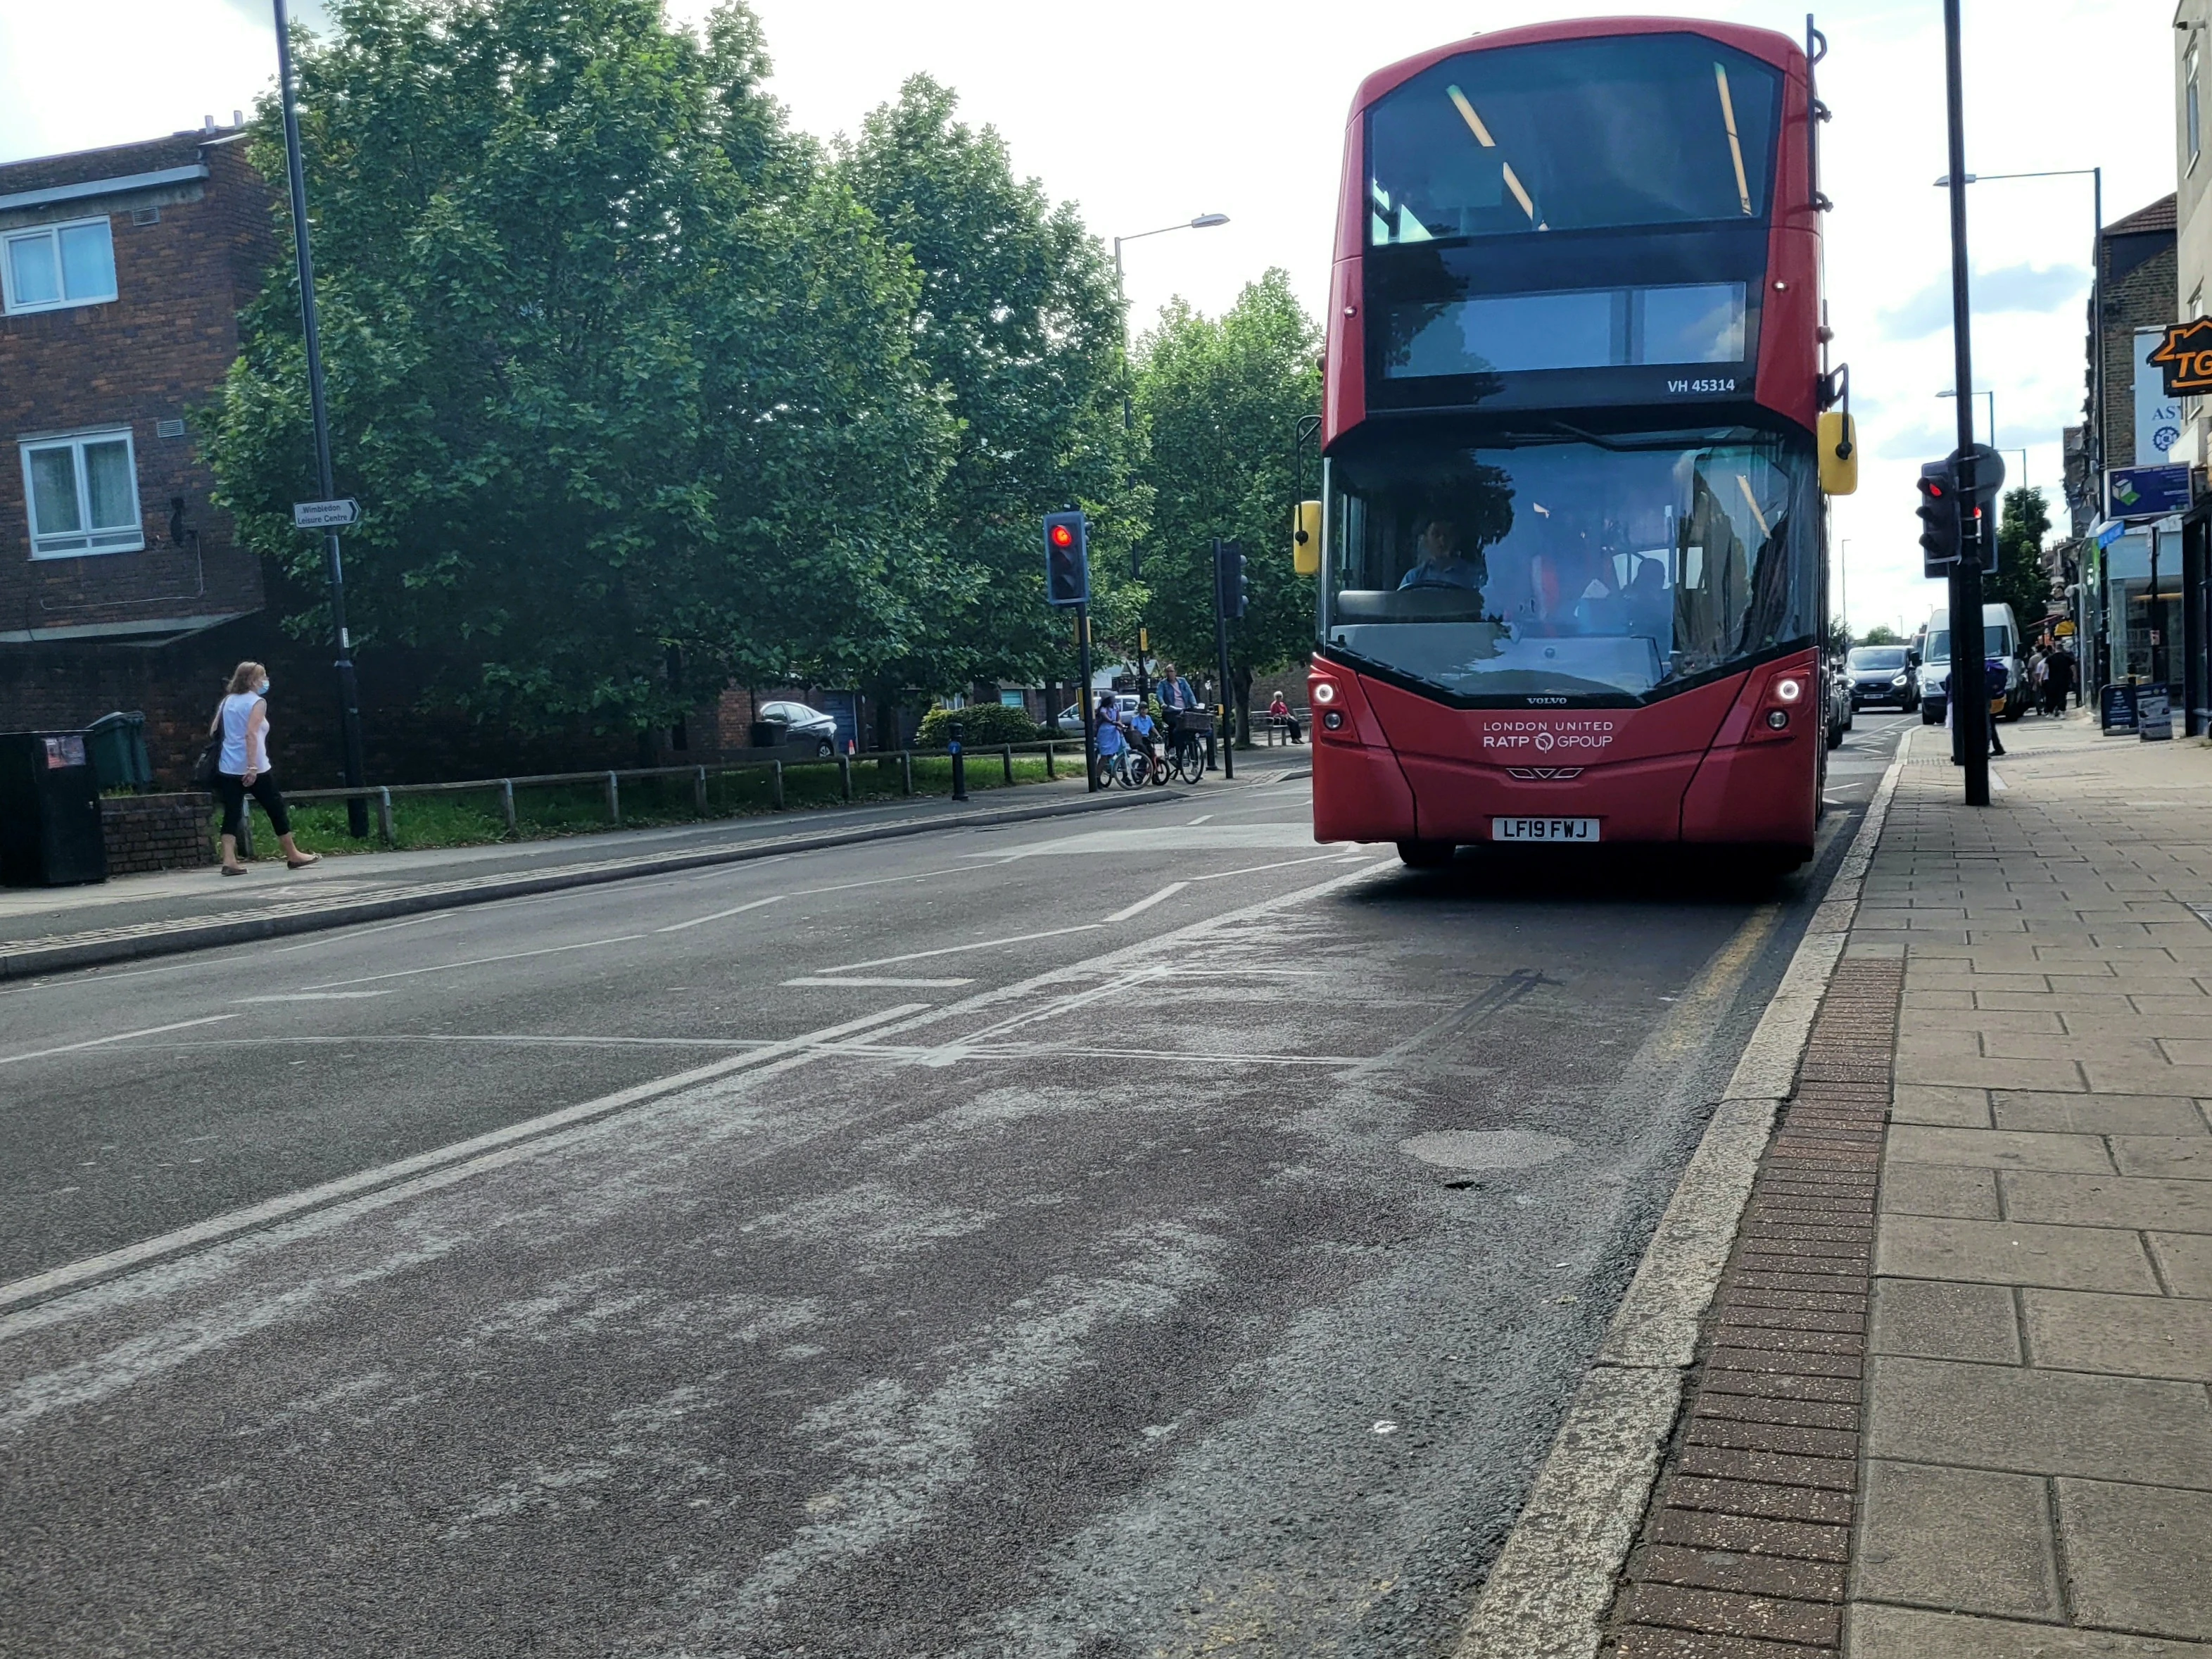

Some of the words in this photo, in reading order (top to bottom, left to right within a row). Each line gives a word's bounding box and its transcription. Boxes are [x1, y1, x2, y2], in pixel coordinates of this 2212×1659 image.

[1667, 379, 1688, 393] VH
[1691, 379, 1736, 392] 45314
[2152, 405, 2181, 421] AS
[302, 505, 341, 514] Wimbledon
[1483, 721, 1548, 731] LONDON
[1555, 721, 1613, 731] UNITED
[1483, 736, 1530, 748] RATP
[1503, 820, 1546, 838] LF19
[1550, 820, 1587, 838] FWJ
